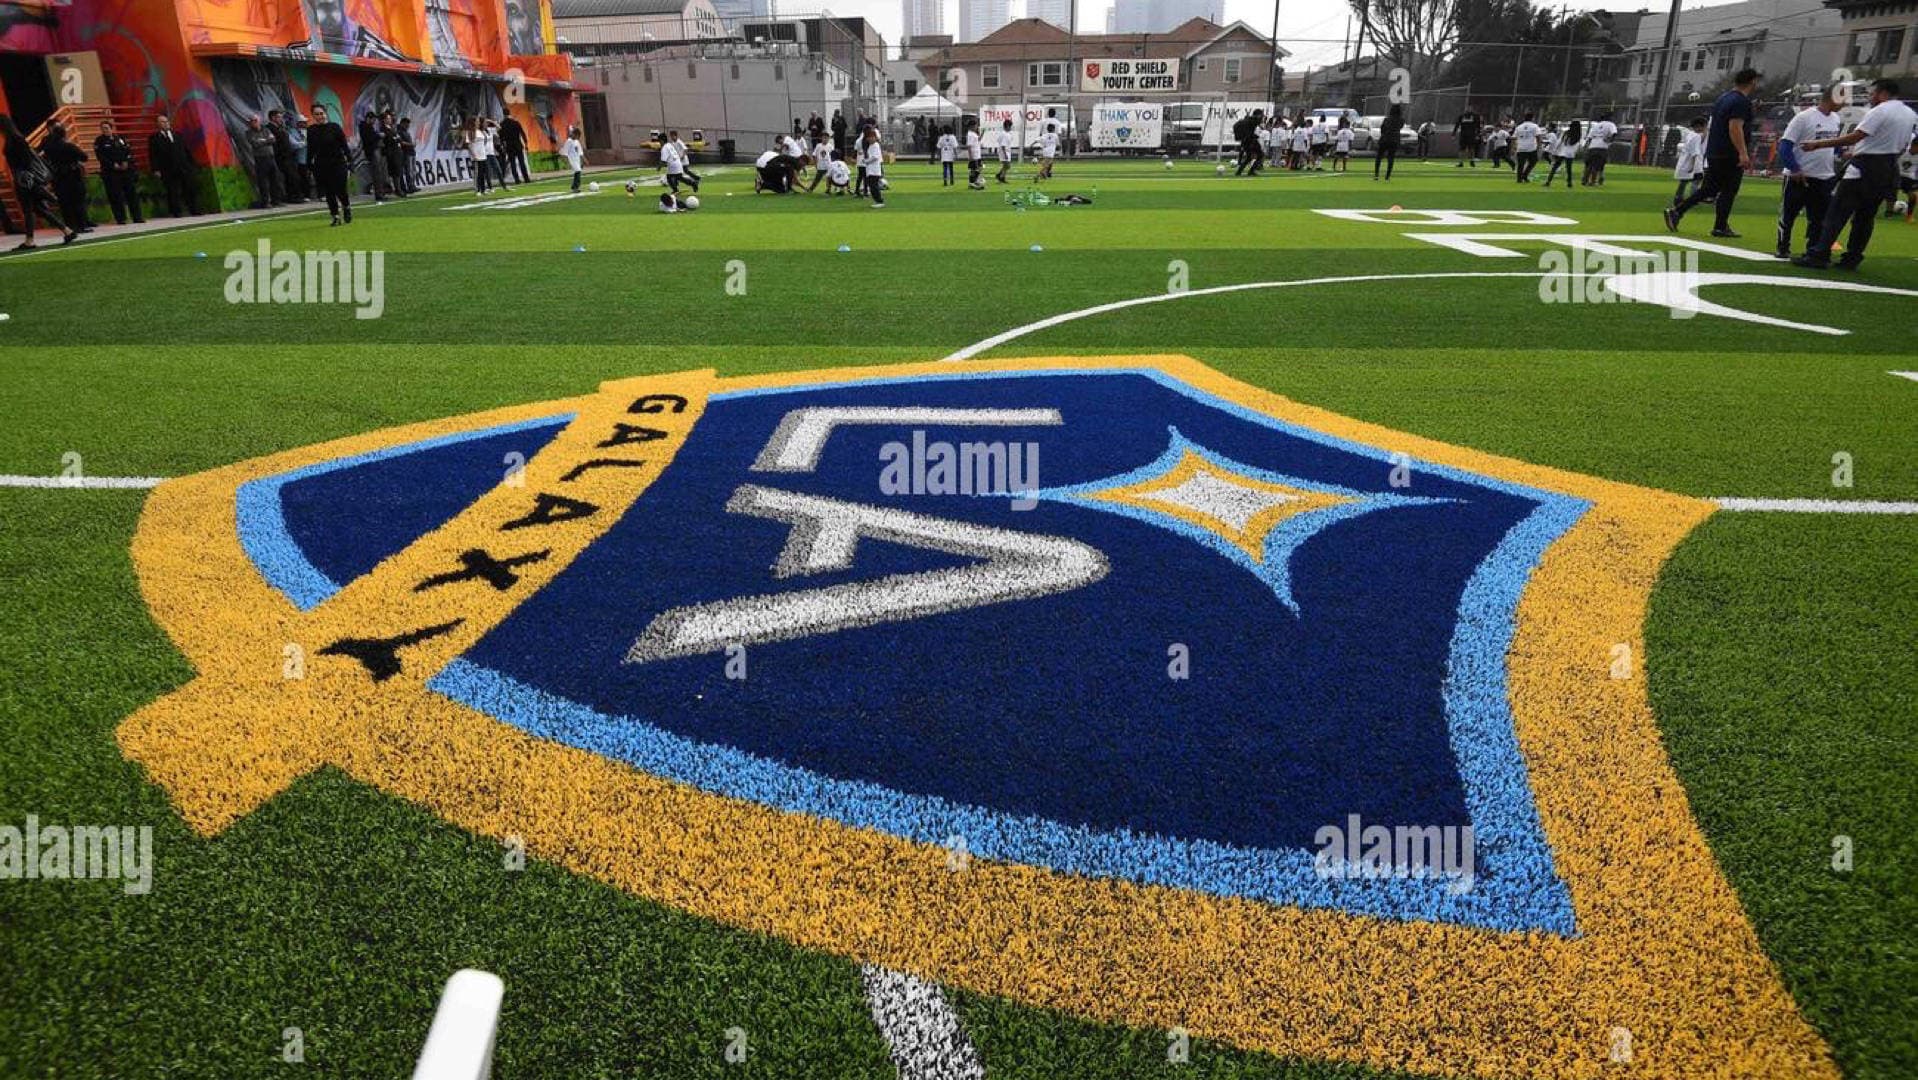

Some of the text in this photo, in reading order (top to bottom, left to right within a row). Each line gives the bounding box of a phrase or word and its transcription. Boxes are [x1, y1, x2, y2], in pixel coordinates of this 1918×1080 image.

[1111, 62, 1168, 75] RED SHIELD
[1103, 76, 1174, 89] YOUTH CENTER
[1100, 109, 1159, 121] THANK YOU
[314, 394, 688, 682] GALAXY
[620, 405, 1111, 665] LA
